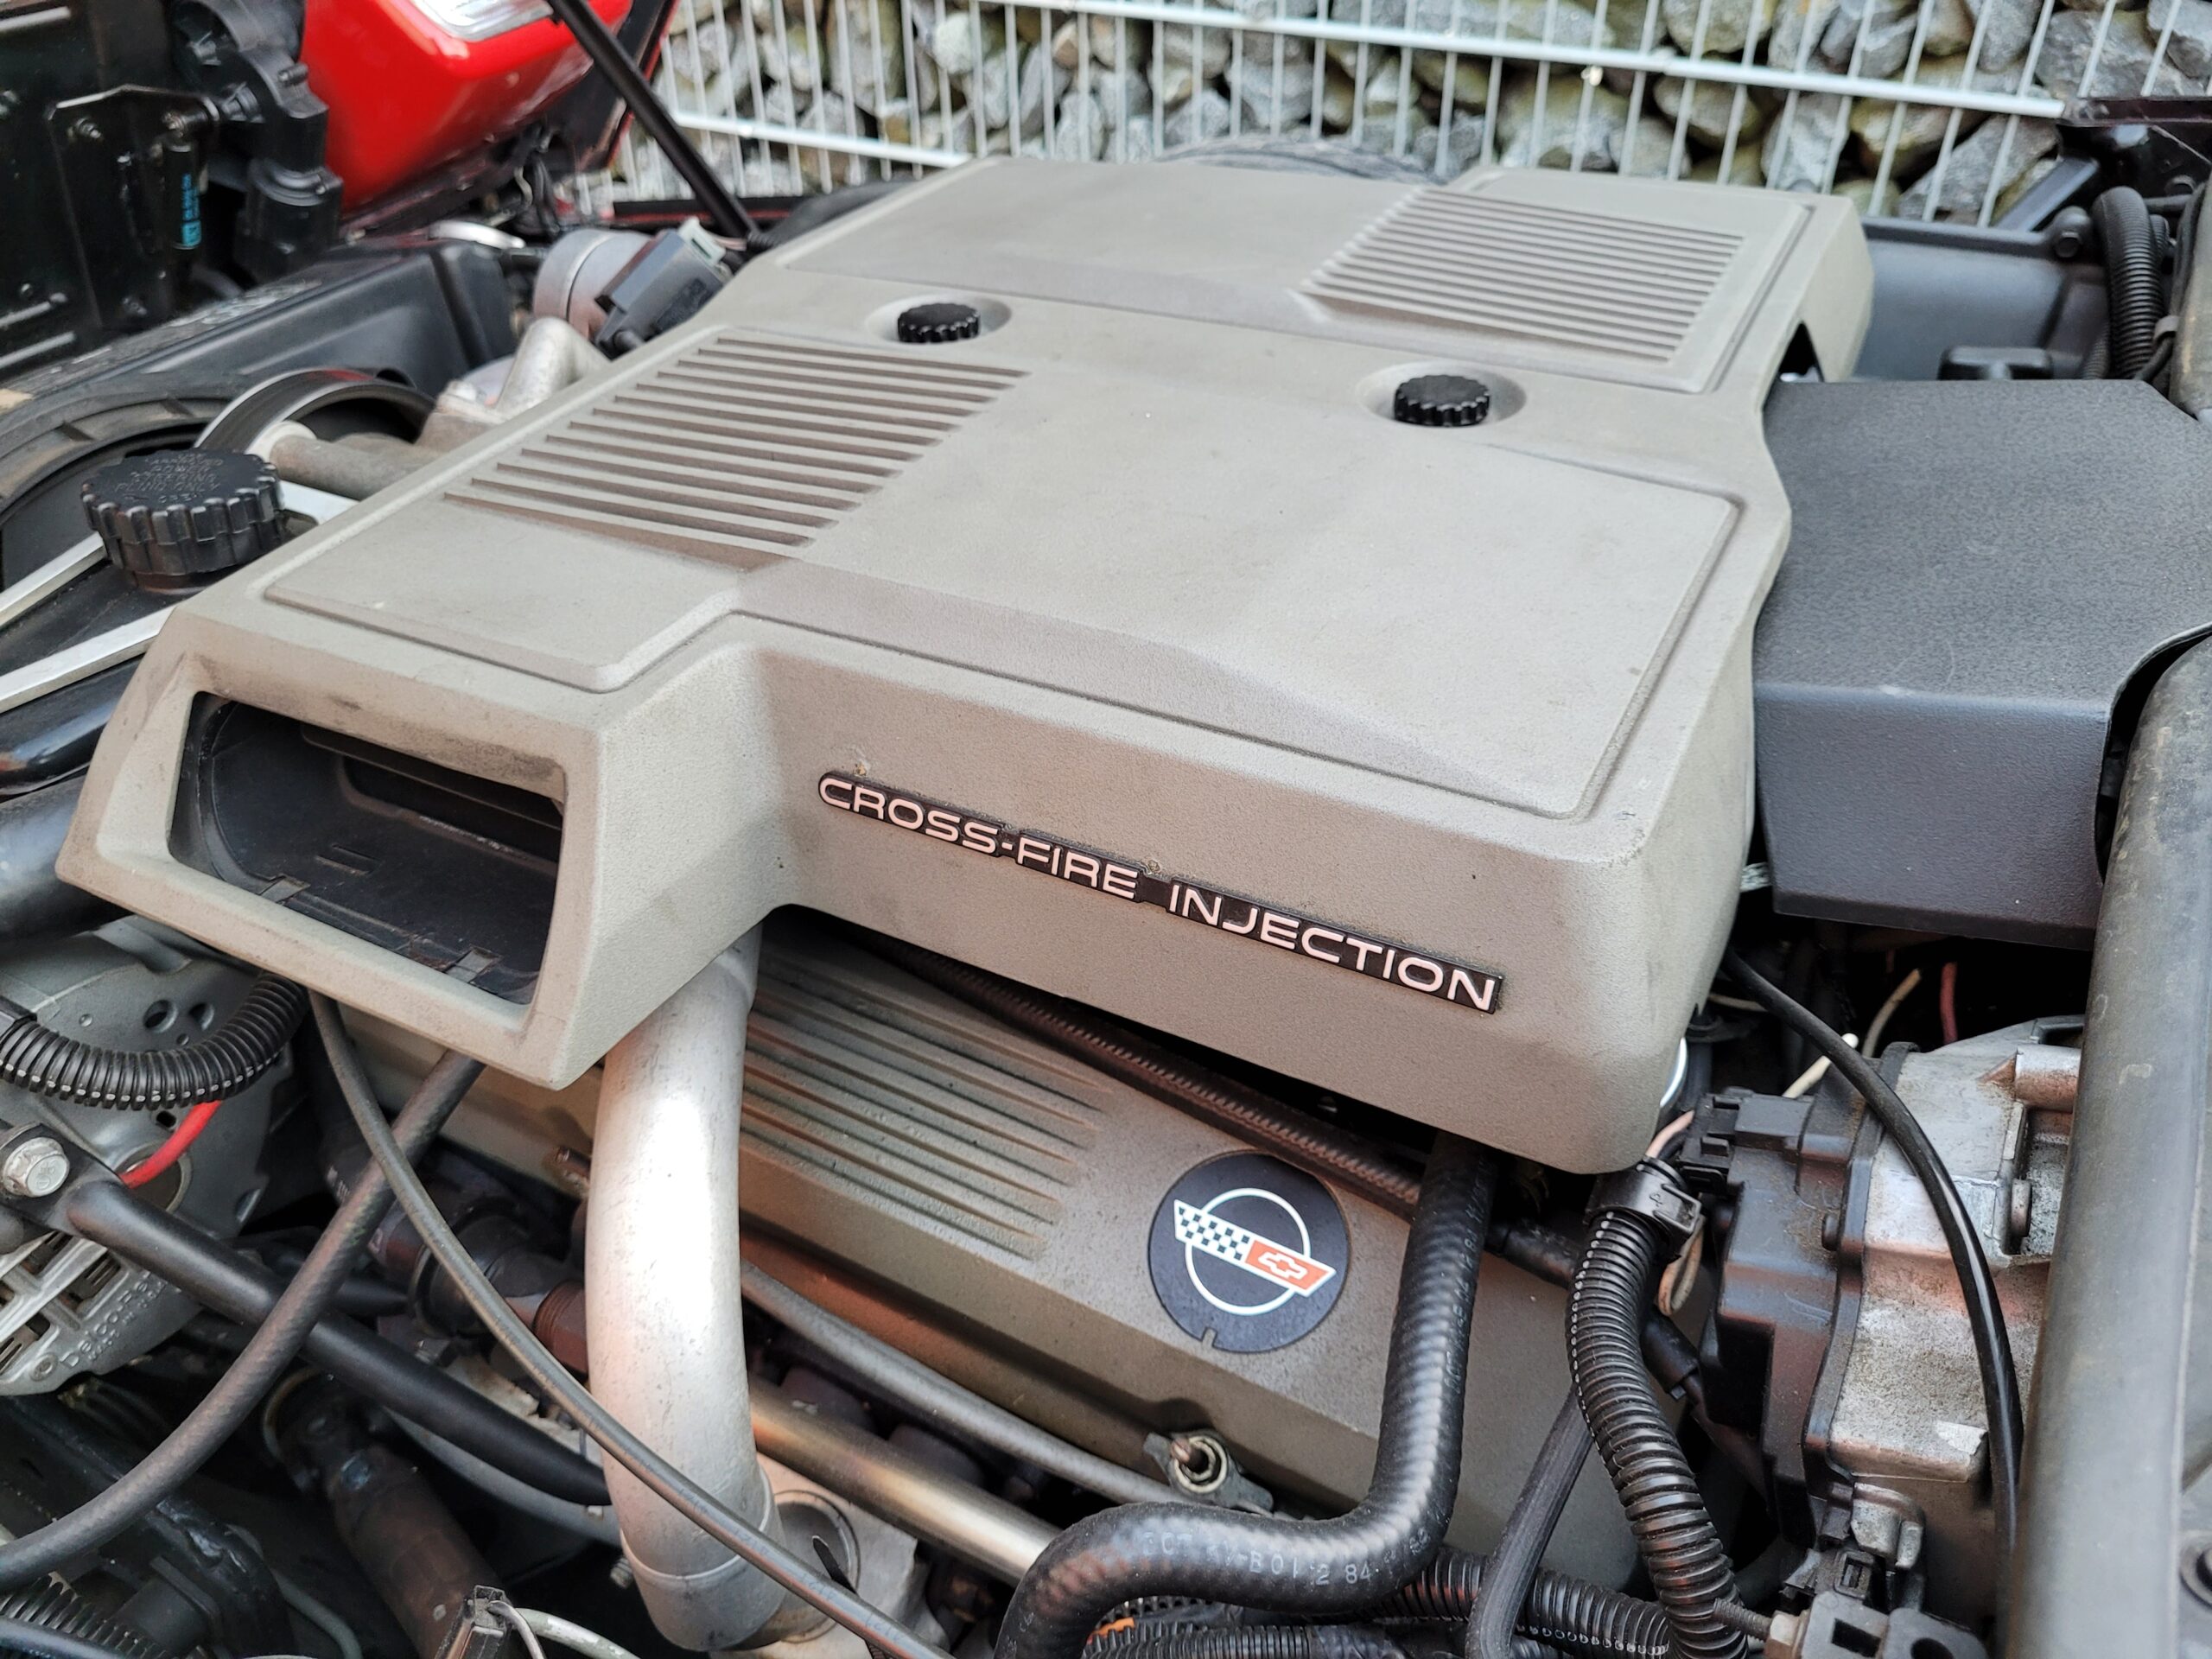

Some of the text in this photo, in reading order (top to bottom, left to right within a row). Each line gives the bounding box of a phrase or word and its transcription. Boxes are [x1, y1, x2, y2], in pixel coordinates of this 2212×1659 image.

[130, 471, 217, 484] STEERING
[820, 778, 1497, 1012] CROSS-FIRE INJECTION
